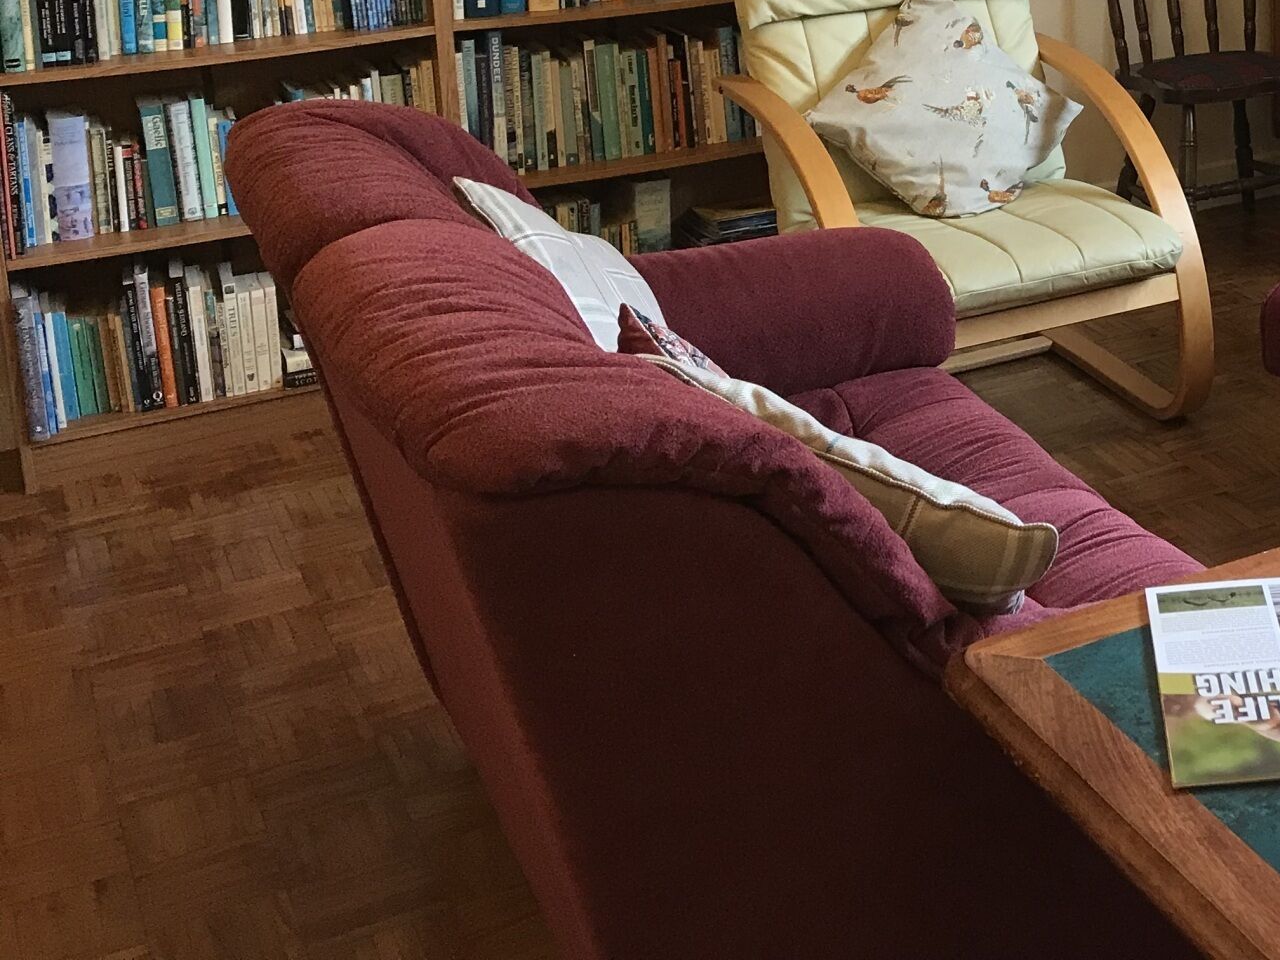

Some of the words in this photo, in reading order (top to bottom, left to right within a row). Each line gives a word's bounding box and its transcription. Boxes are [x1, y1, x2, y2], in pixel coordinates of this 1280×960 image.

[491, 37, 501, 82] DUNDEE
[5, 126, 14, 152] CLANS
[152, 116, 165, 147] Gaelic
[9, 161, 18, 196] TARTANS
[228, 306, 237, 337] TREES
